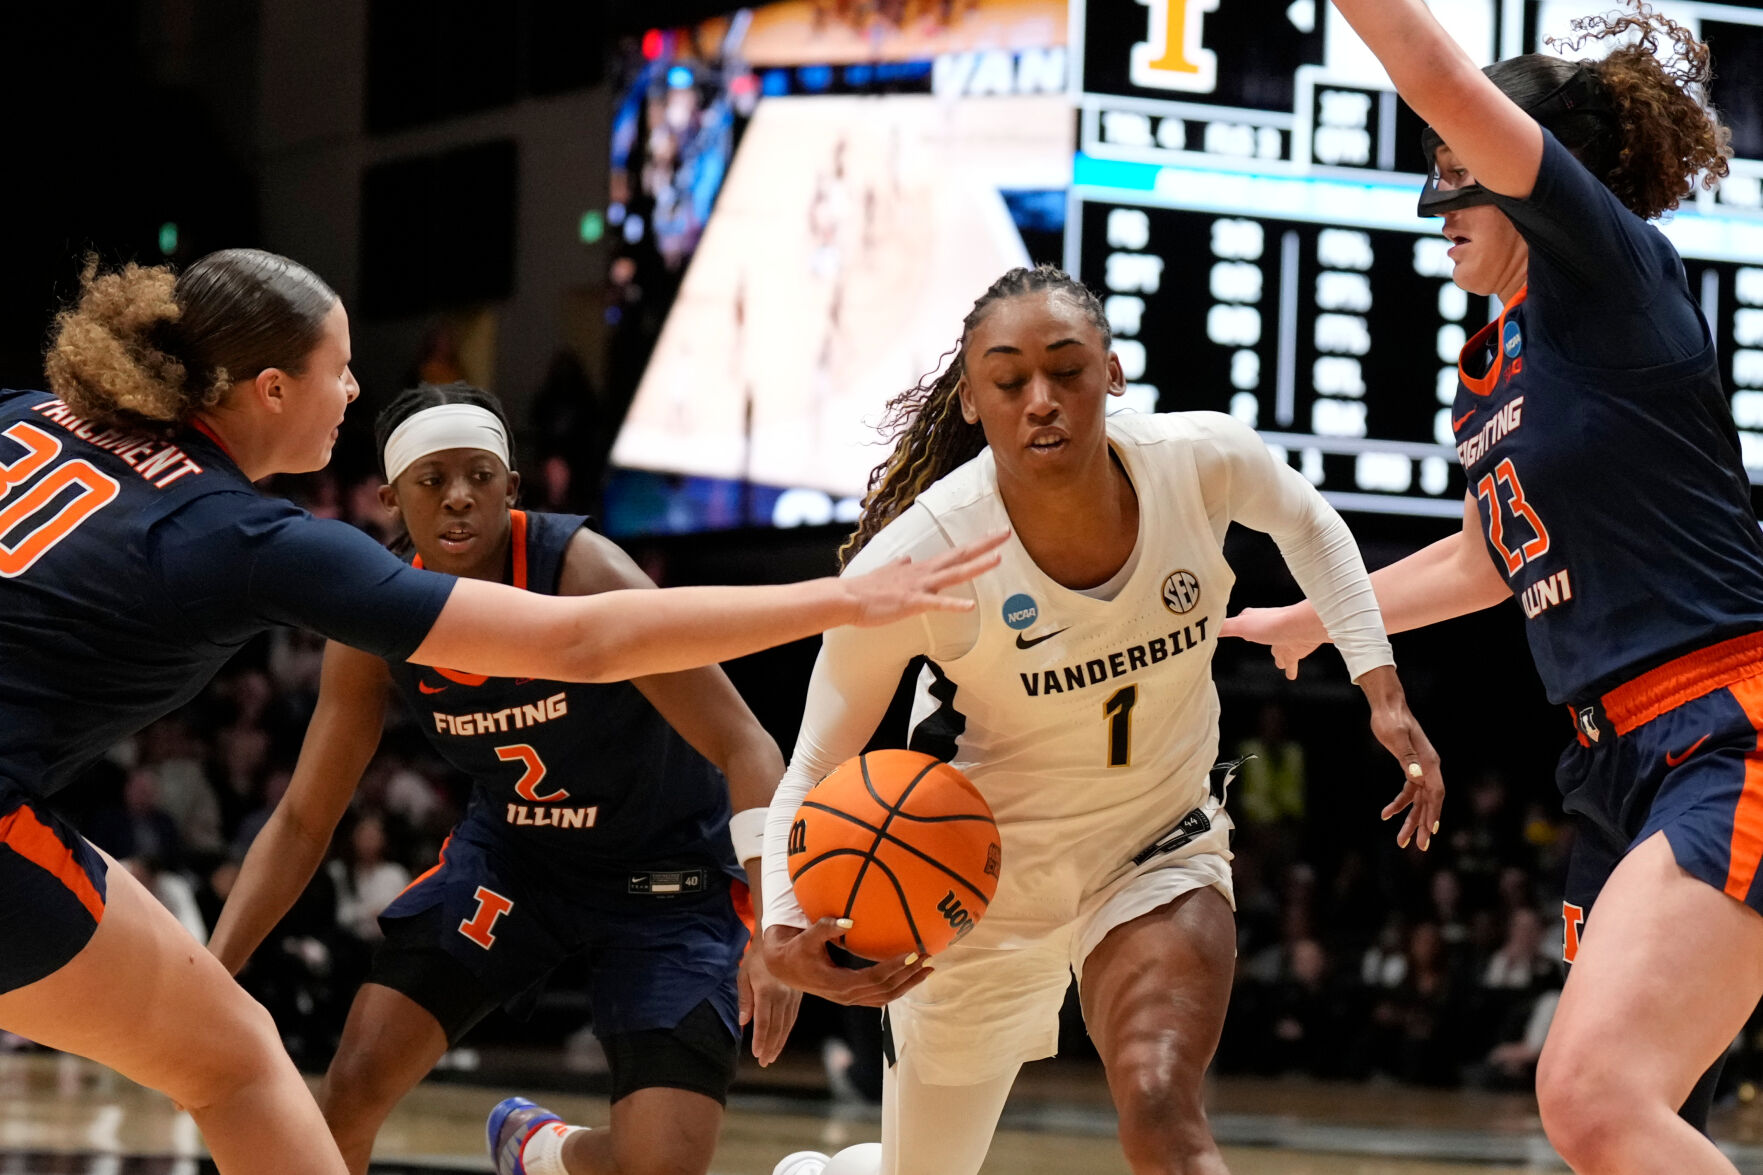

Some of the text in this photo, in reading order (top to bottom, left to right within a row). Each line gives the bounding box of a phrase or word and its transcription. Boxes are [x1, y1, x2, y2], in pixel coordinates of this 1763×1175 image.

[1456, 395, 1525, 470] FIGHTING
[0, 420, 120, 578] 30
[1477, 457, 1550, 578] 23
[1008, 607, 1036, 623] NCAA
[1163, 571, 1199, 613] SEC
[1020, 616, 1208, 696] VANDERBILT
[433, 691, 568, 736] FIGHTING
[1102, 683, 1138, 768] 1
[494, 743, 570, 803] 2
[505, 803, 598, 829] ILLINI
[1184, 817, 1199, 827] 44
[685, 876, 698, 886] 40
[458, 885, 514, 950] I
